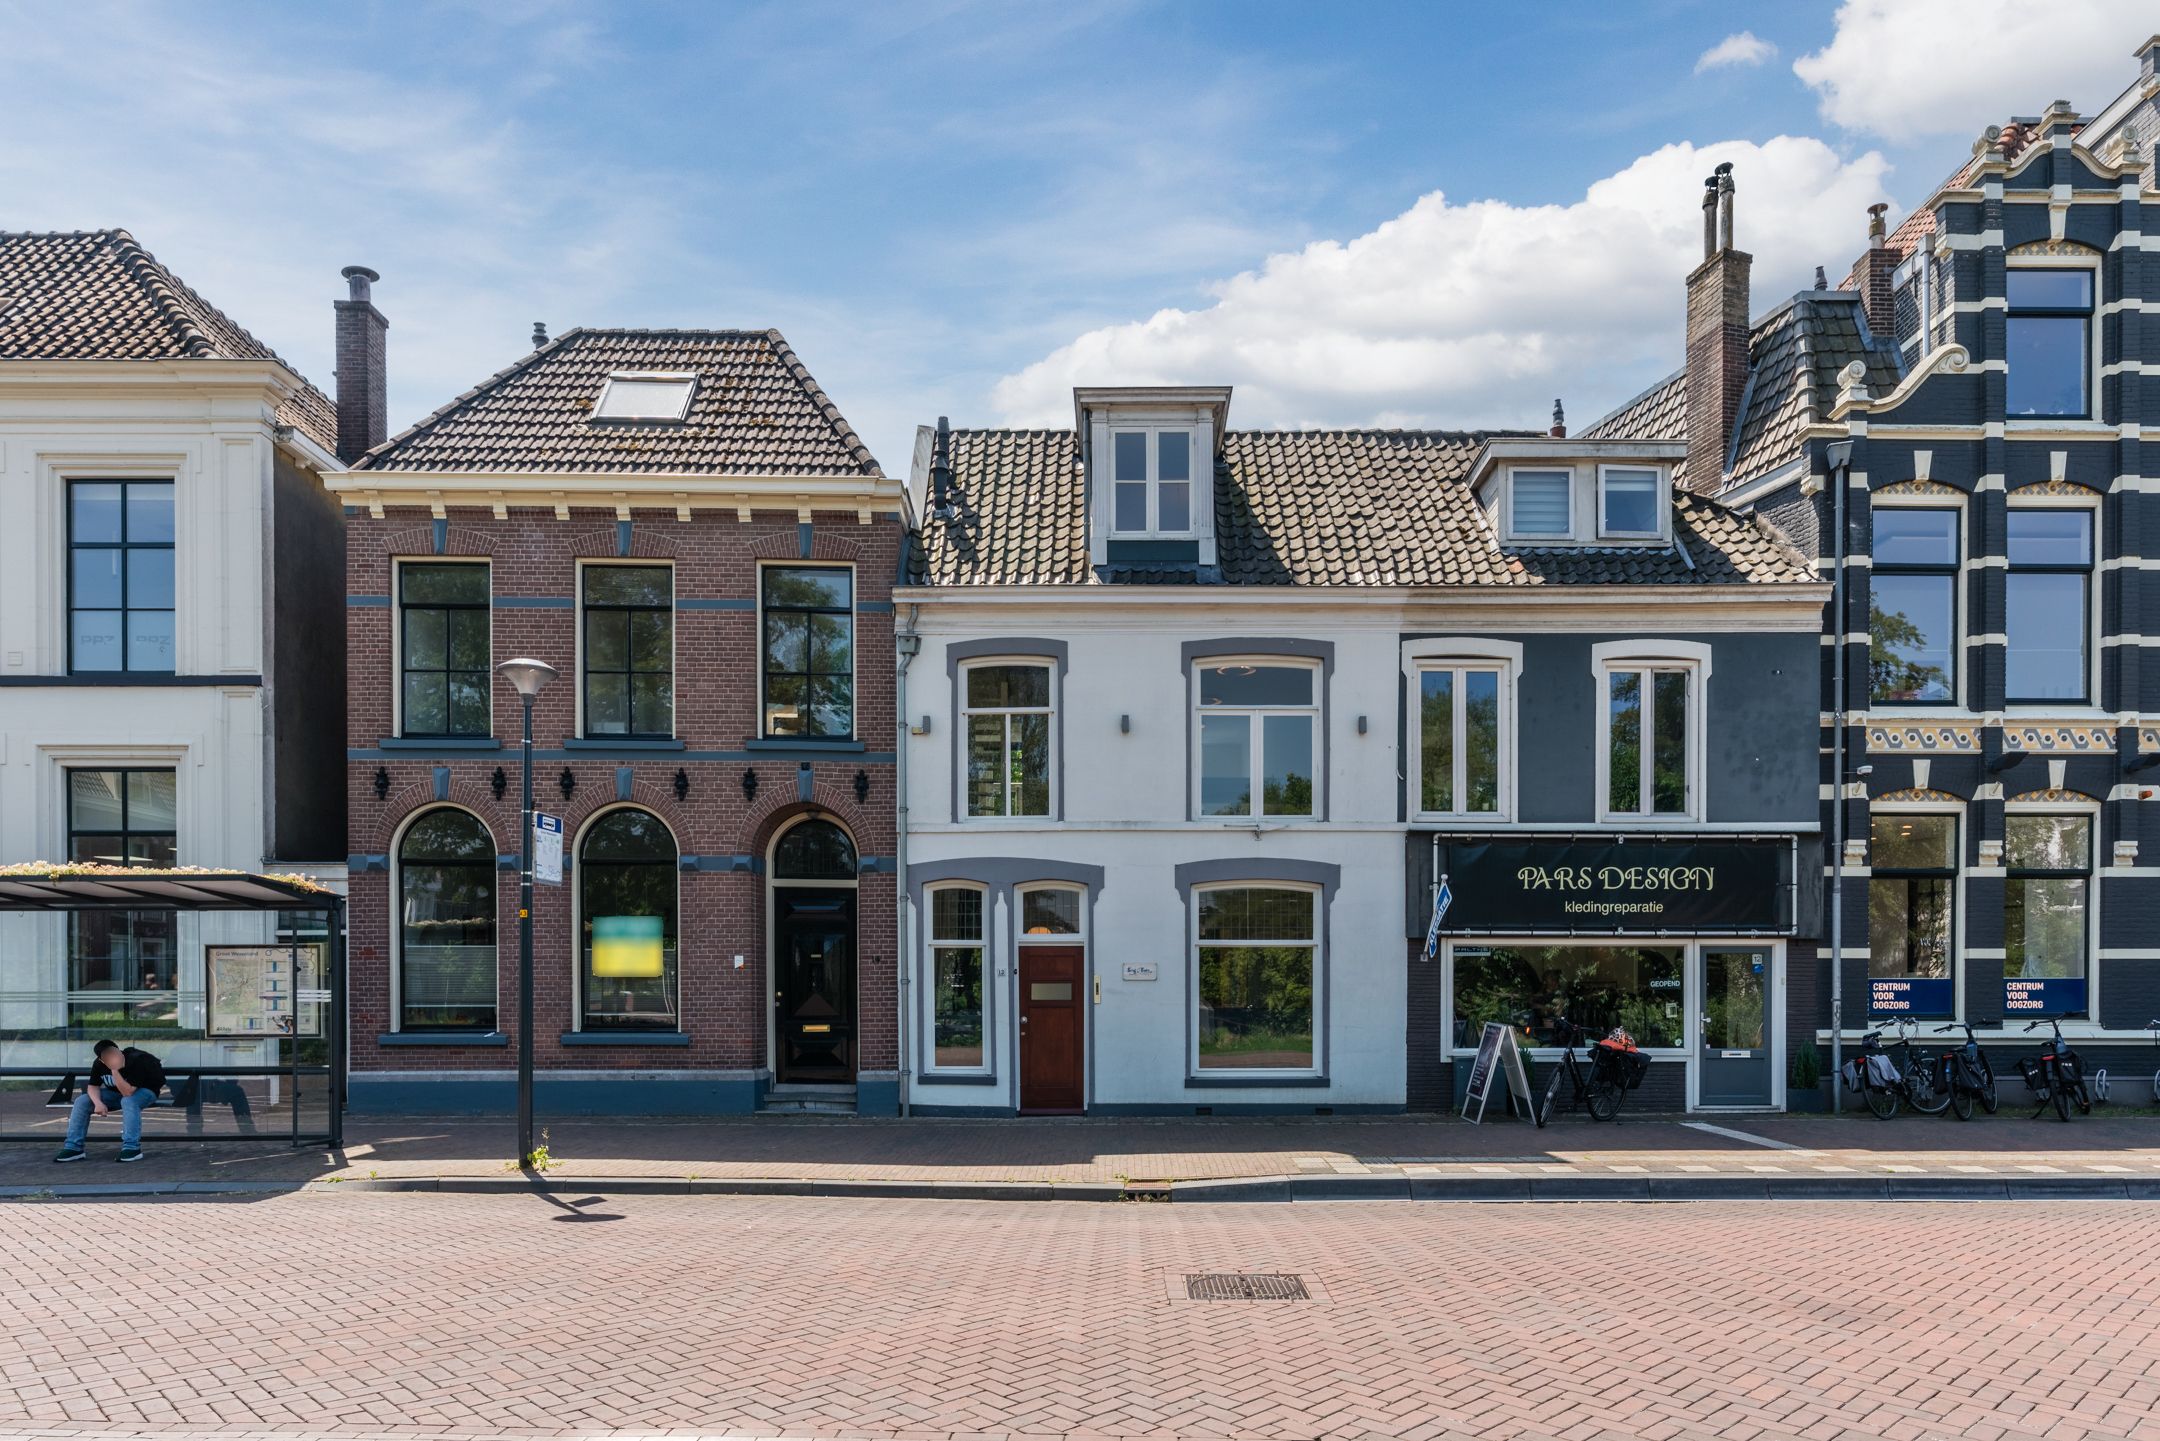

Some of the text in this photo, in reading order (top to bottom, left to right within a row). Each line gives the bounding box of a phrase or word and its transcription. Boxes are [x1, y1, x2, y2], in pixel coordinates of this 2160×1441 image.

[1518, 866, 1714, 891] PARS DESIGN
[1565, 901, 1663, 915] kledingreparatie
[1754, 955, 1762, 963] 12
[1650, 980, 1681, 988] GEOPEND
[1873, 982, 1910, 991] CENTRUM
[2006, 982, 2044, 991] CENTRUM
[1873, 992, 1895, 1000] VOOR
[2006, 991, 2028, 1000] VOOR
[1873, 1001, 1910, 1009] OOGZORG
[2006, 1000, 2044, 1009] OOGZORG
